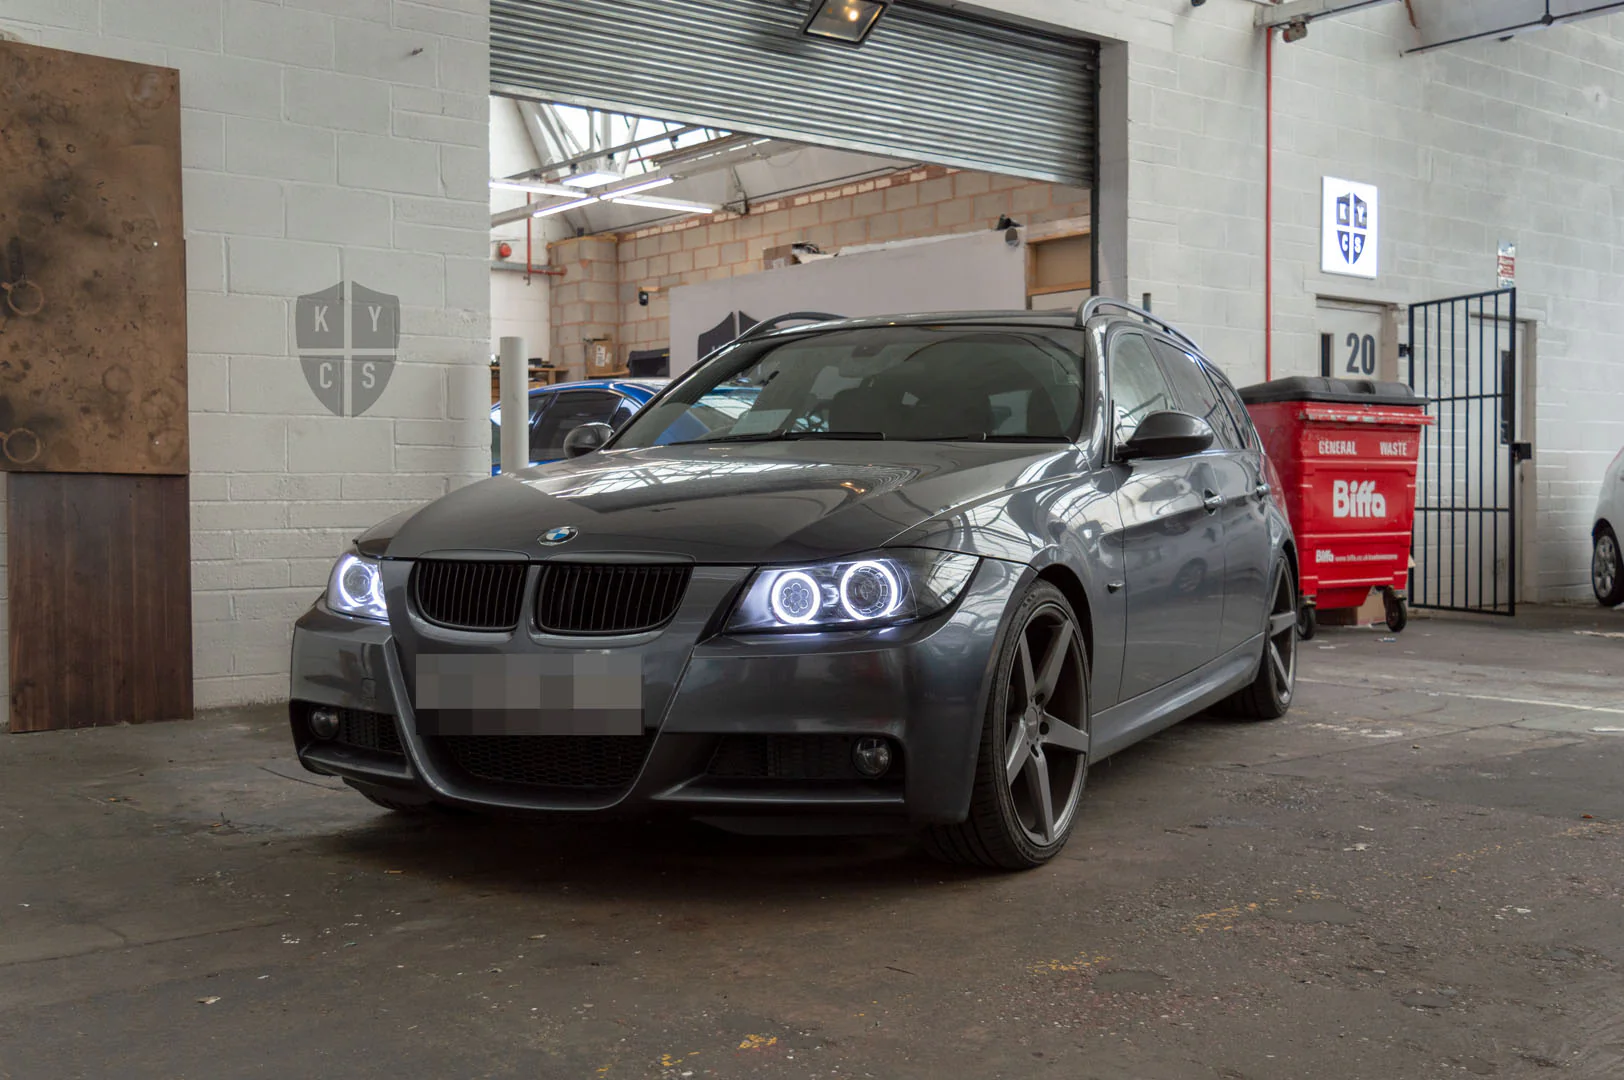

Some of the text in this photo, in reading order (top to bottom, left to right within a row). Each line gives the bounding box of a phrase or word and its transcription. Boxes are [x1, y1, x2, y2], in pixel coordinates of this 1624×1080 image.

[1346, 332, 1375, 375] 20
[1318, 440, 1407, 456] GENERAL WASTE
[1333, 480, 1386, 518] Biffa
[1315, 549, 1334, 563] Biffa
